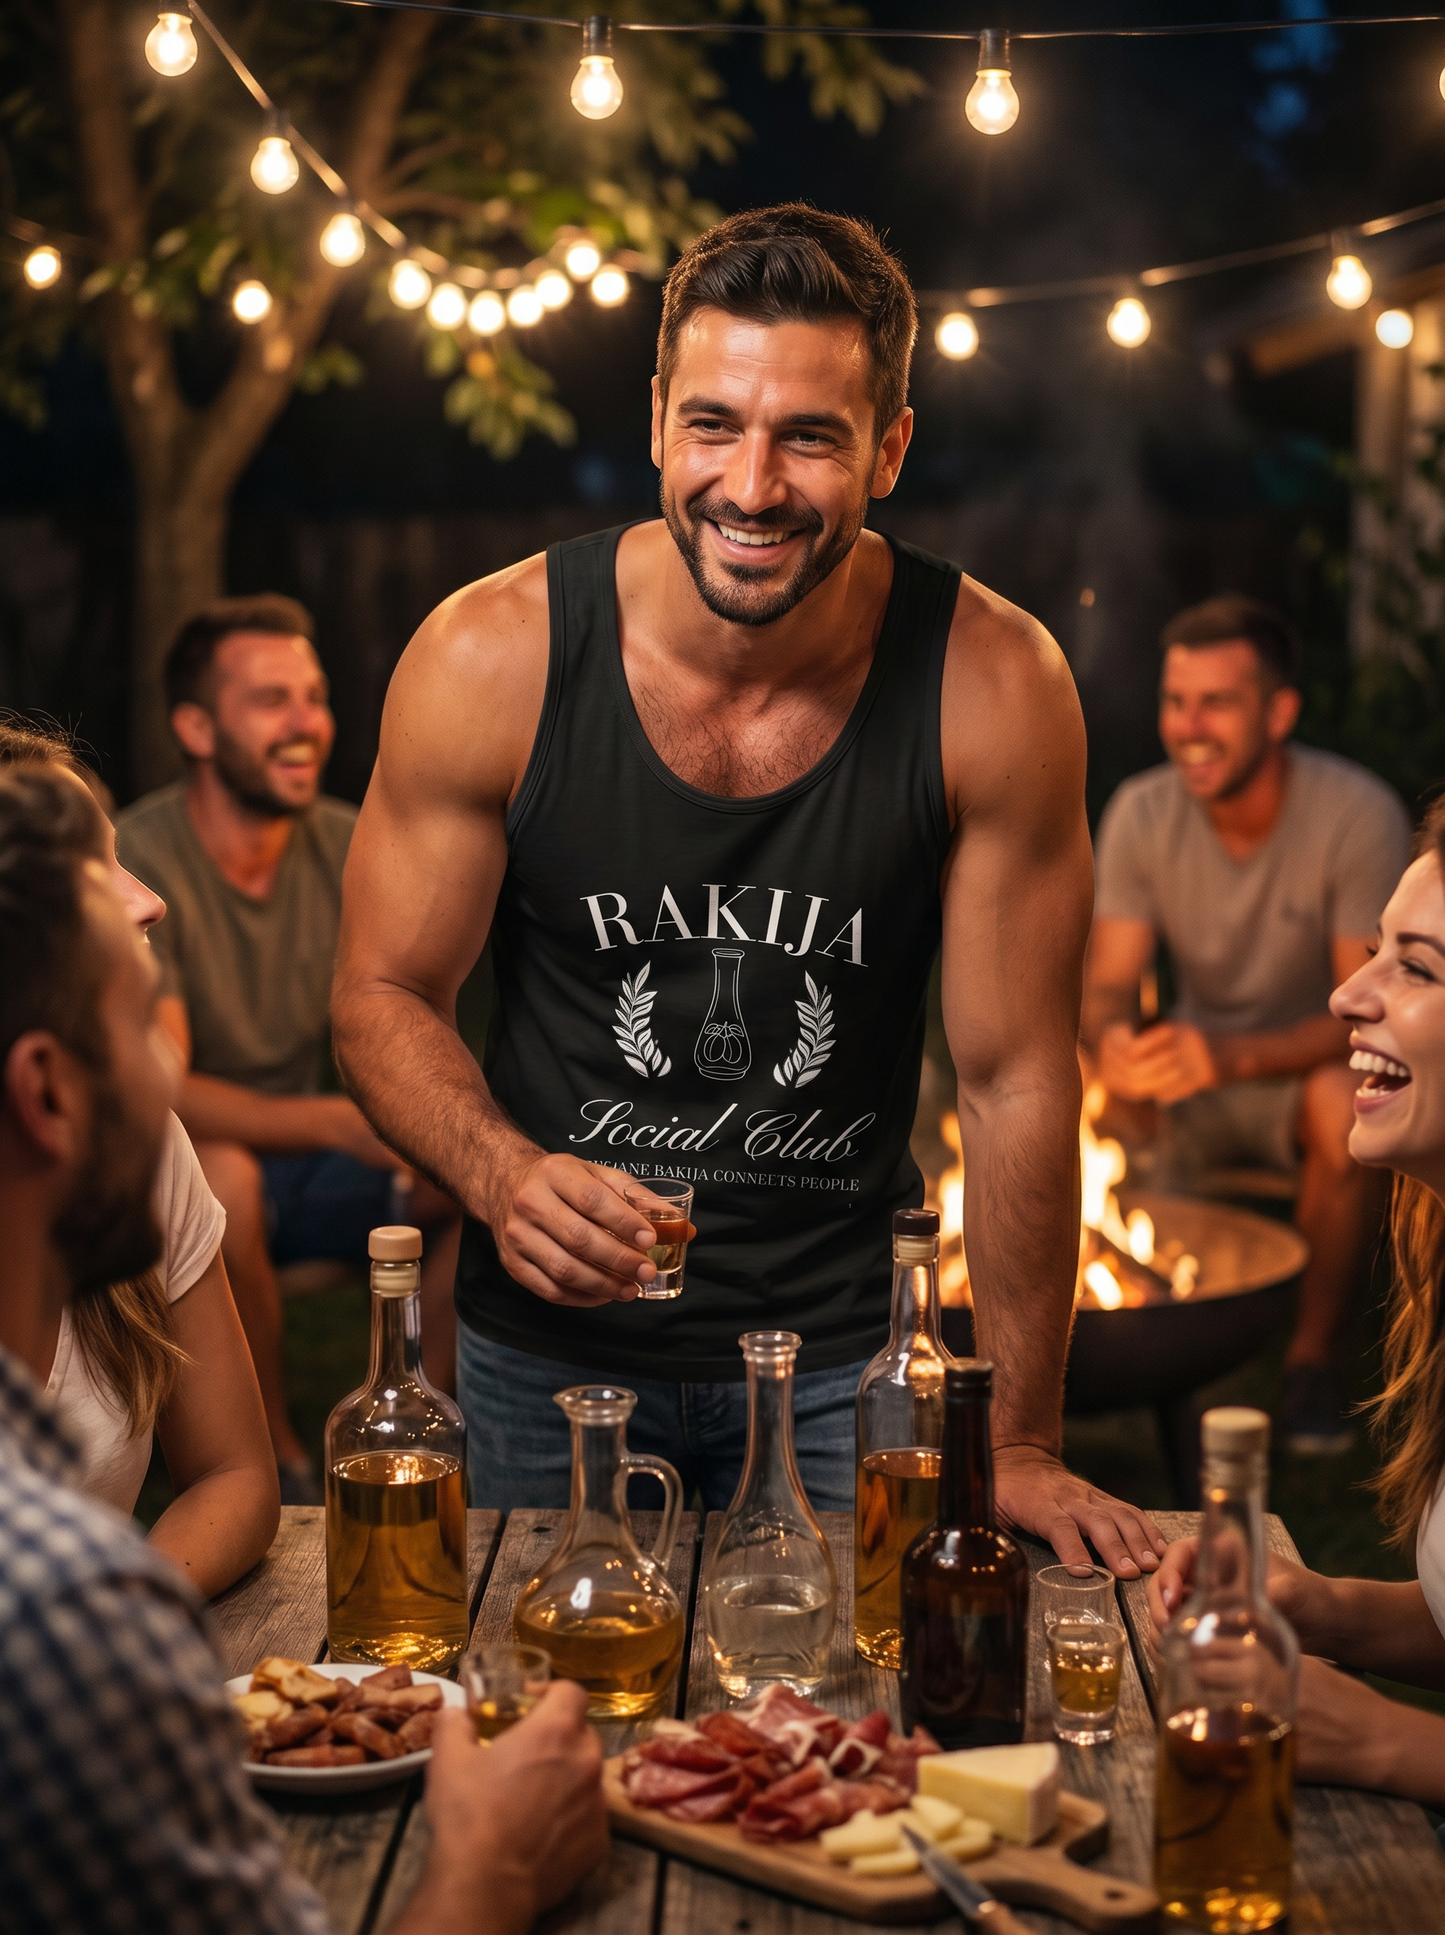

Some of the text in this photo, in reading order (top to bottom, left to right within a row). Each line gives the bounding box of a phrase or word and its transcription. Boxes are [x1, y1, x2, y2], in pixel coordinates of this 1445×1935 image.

[579, 883, 869, 968] RAKIJA
[567, 1098, 877, 1162] Social Club
[653, 1164, 710, 1183] BAKIJA
[799, 1177, 861, 1193] PEOPLE
